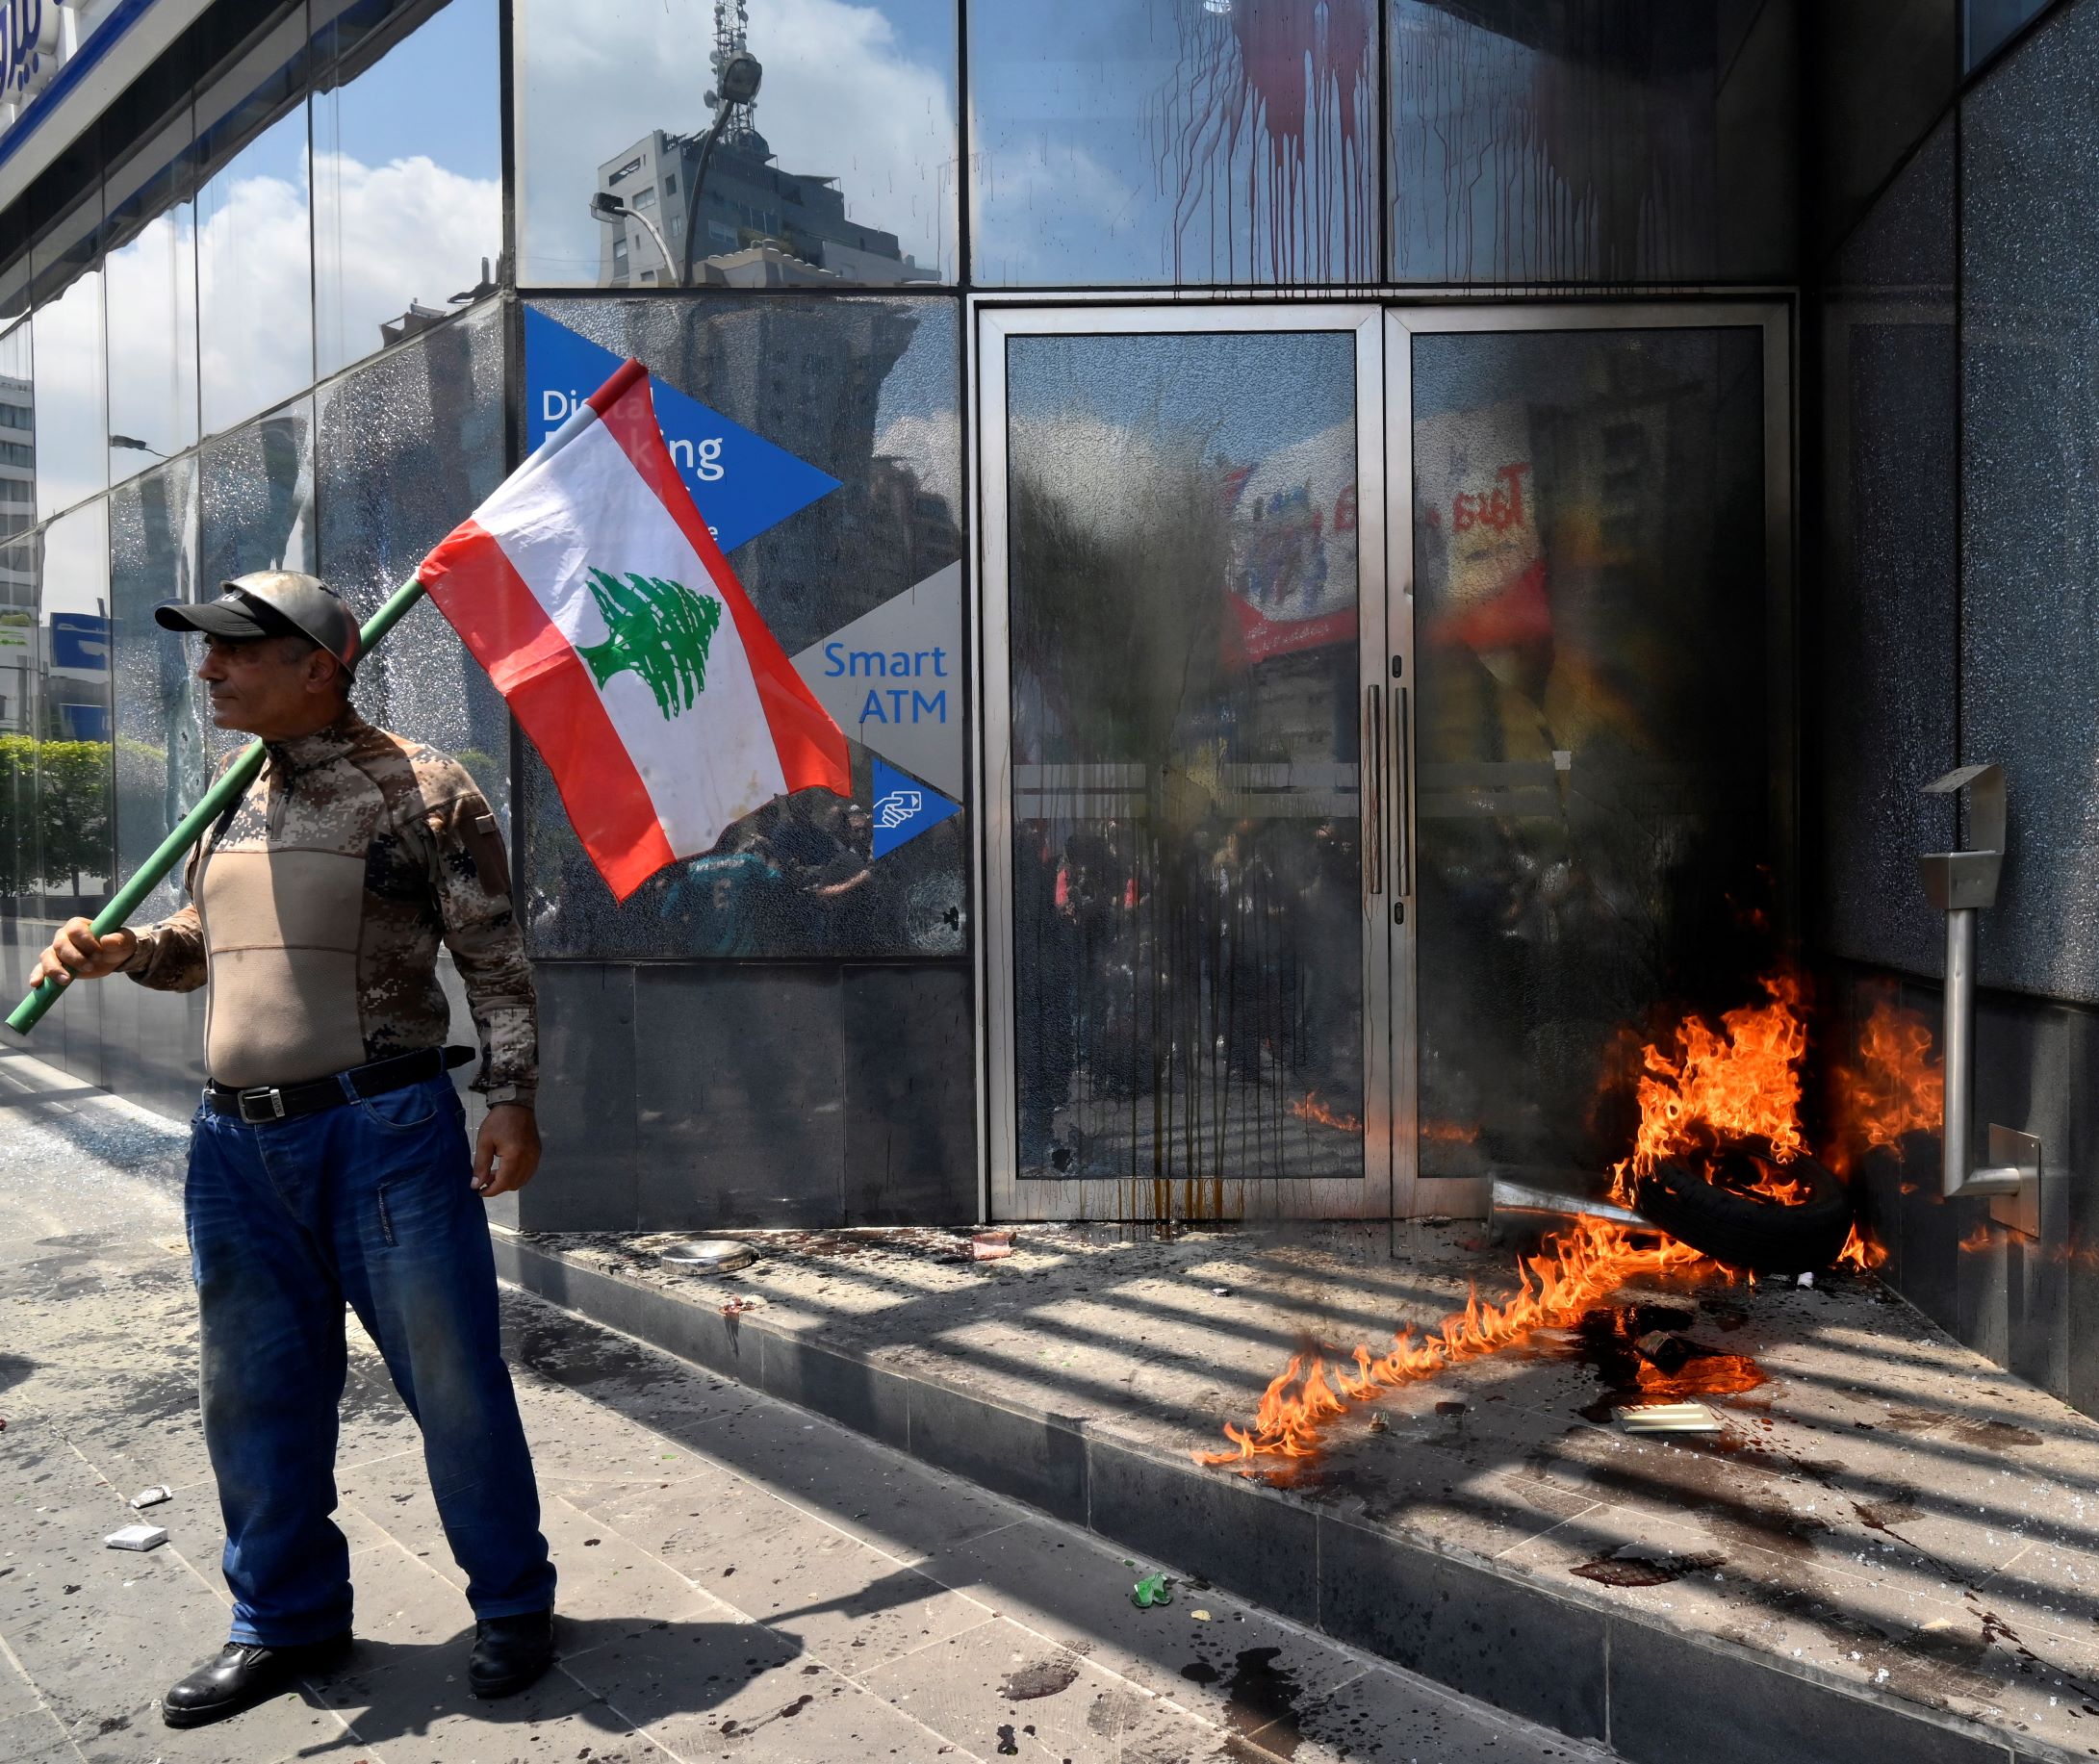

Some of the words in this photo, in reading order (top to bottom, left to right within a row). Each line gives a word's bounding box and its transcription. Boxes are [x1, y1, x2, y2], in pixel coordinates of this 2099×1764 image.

[543, 387, 657, 421] Dita
[824, 642, 948, 677] Smart
[858, 689, 946, 724] ATM
